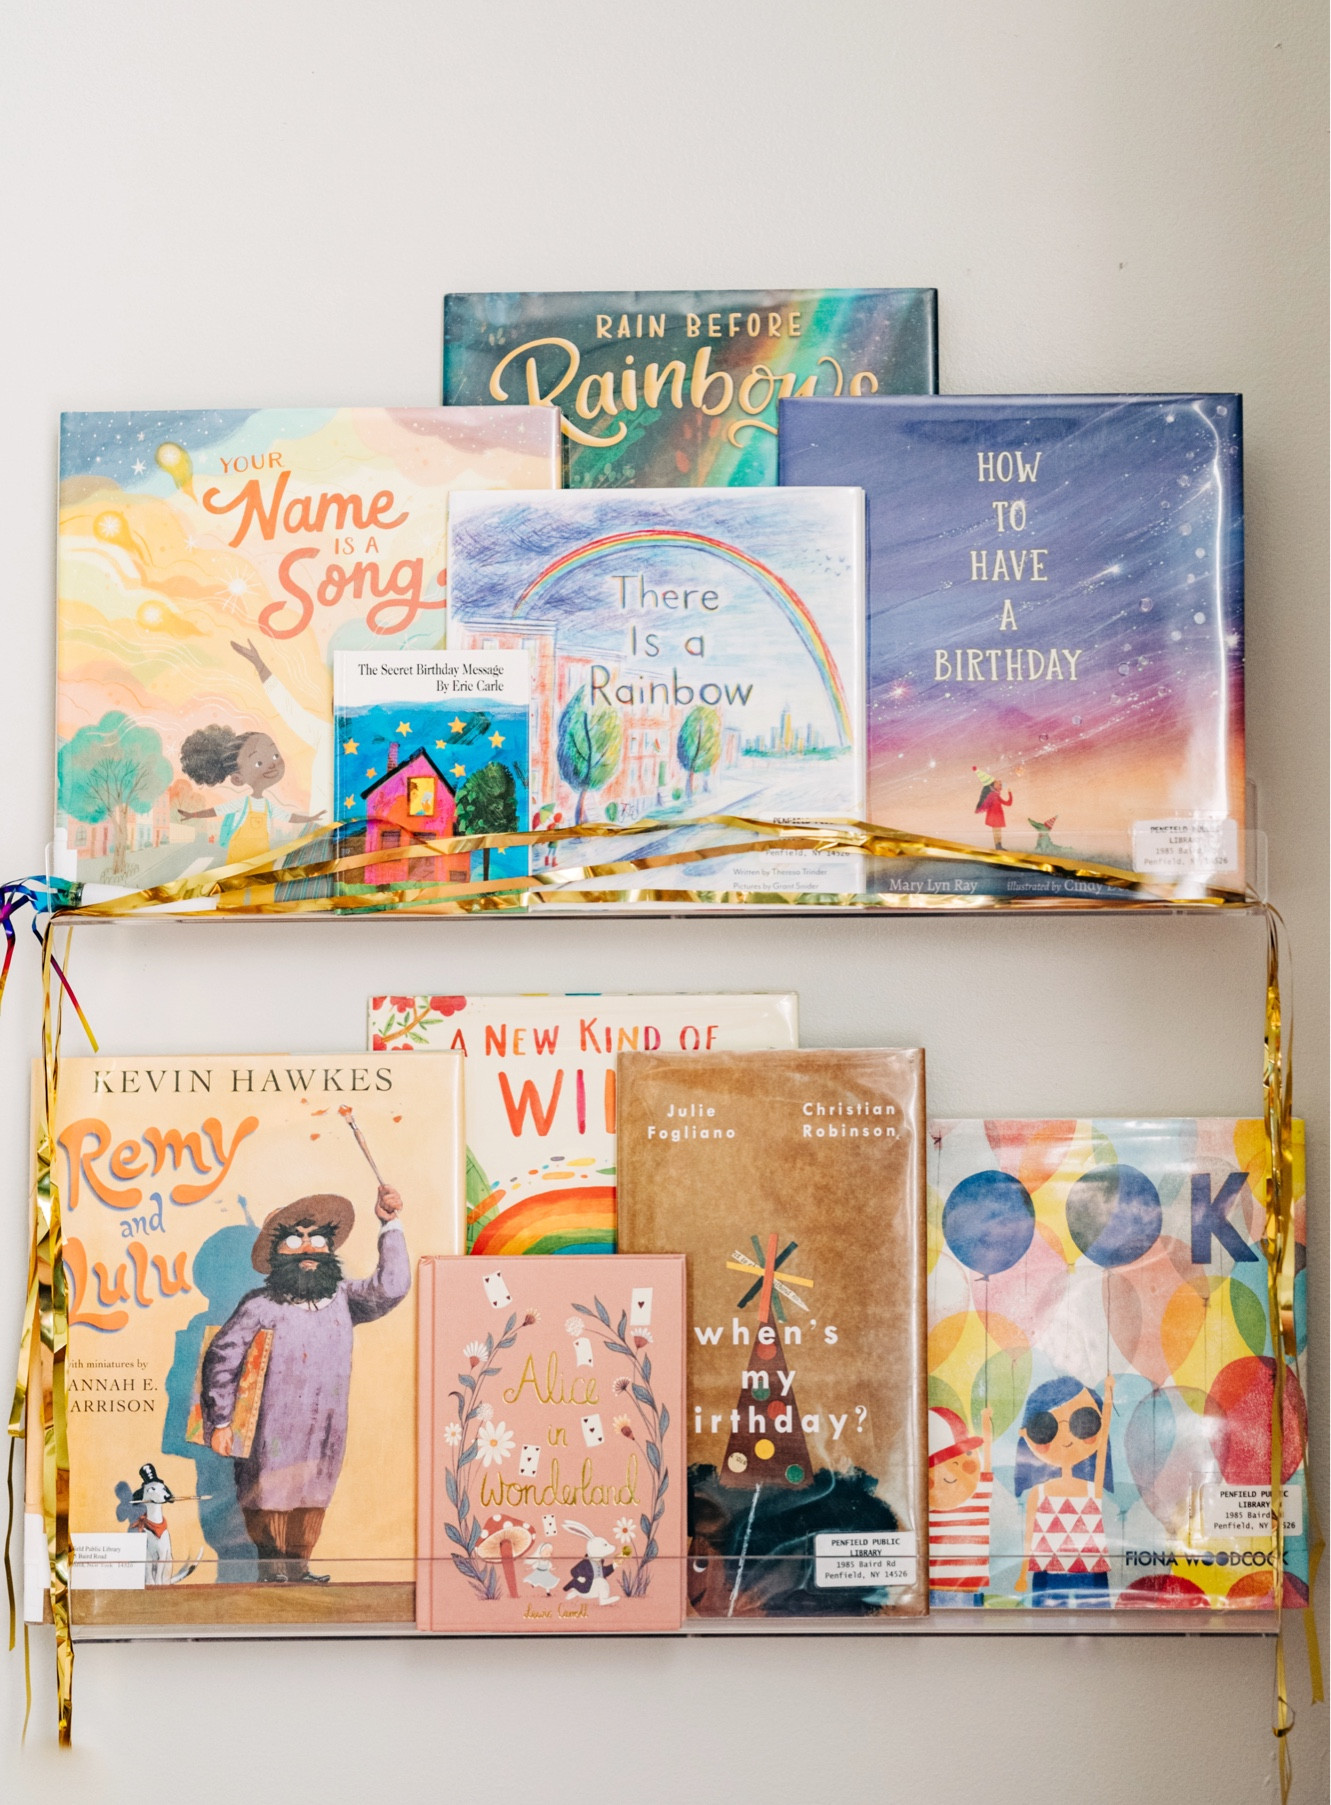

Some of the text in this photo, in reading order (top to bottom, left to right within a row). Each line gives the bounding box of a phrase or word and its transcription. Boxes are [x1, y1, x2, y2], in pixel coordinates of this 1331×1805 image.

[596, 311, 803, 338] RAIN BEFORE
[219, 452, 283, 474] YOUR
[977, 451, 1042, 483] HOW
[202, 471, 409, 548] Name
[992, 501, 1027, 532] TO
[333, 535, 379, 555] IS A
[970, 549, 1049, 582] HAVE
[259, 547, 447, 640] Song
[610, 573, 720, 611] There
[999, 599, 1018, 631] A
[630, 625, 706, 659] Is a
[358, 663, 505, 678] The Secret Birthday Message
[934, 649, 1082, 681] BIRTHDAY
[436, 679, 505, 693] By Eric Carle
[590, 664, 754, 707] Rainbow
[733, 882, 761, 890] Pictures
[889, 878, 978, 894] Mary Lyn Ray
[1007, 881, 1050, 891] illustrated
[1051, 881, 1062, 894] by
[449, 1017, 719, 1057] A NEW KIND OF
[93, 1068, 393, 1094] KEVIN HAWKES
[666, 1104, 716, 1118] Julie
[803, 1102, 896, 1116] Christian
[648, 1126, 736, 1142] Fogliano
[803, 1124, 896, 1138] Robinson
[57, 1115, 260, 1211] Remy
[120, 1192, 165, 1239] and
[62, 1237, 192, 1333] Lulu
[68, 1359, 148, 1370] ith miniatures by
[68, 1379, 158, 1391] ANNAH E.
[502, 1351, 600, 1405] Alice
[741, 1370, 796, 1396] my
[70, 1399, 155, 1412] ARRISON
[694, 1405, 868, 1440] irthday?
[547, 1424, 568, 1447] in
[1213, 1522, 1254, 1530] Penfield,
[1247, 1511, 1271, 1519] Baird
[850, 1549, 882, 1557] LIBRARY
[872, 1538, 900, 1546] PUBLIC
[858, 1560, 882, 1568] Baird
[1125, 1551, 1178, 1566] FIONA
[825, 1571, 866, 1579] Penfield,
